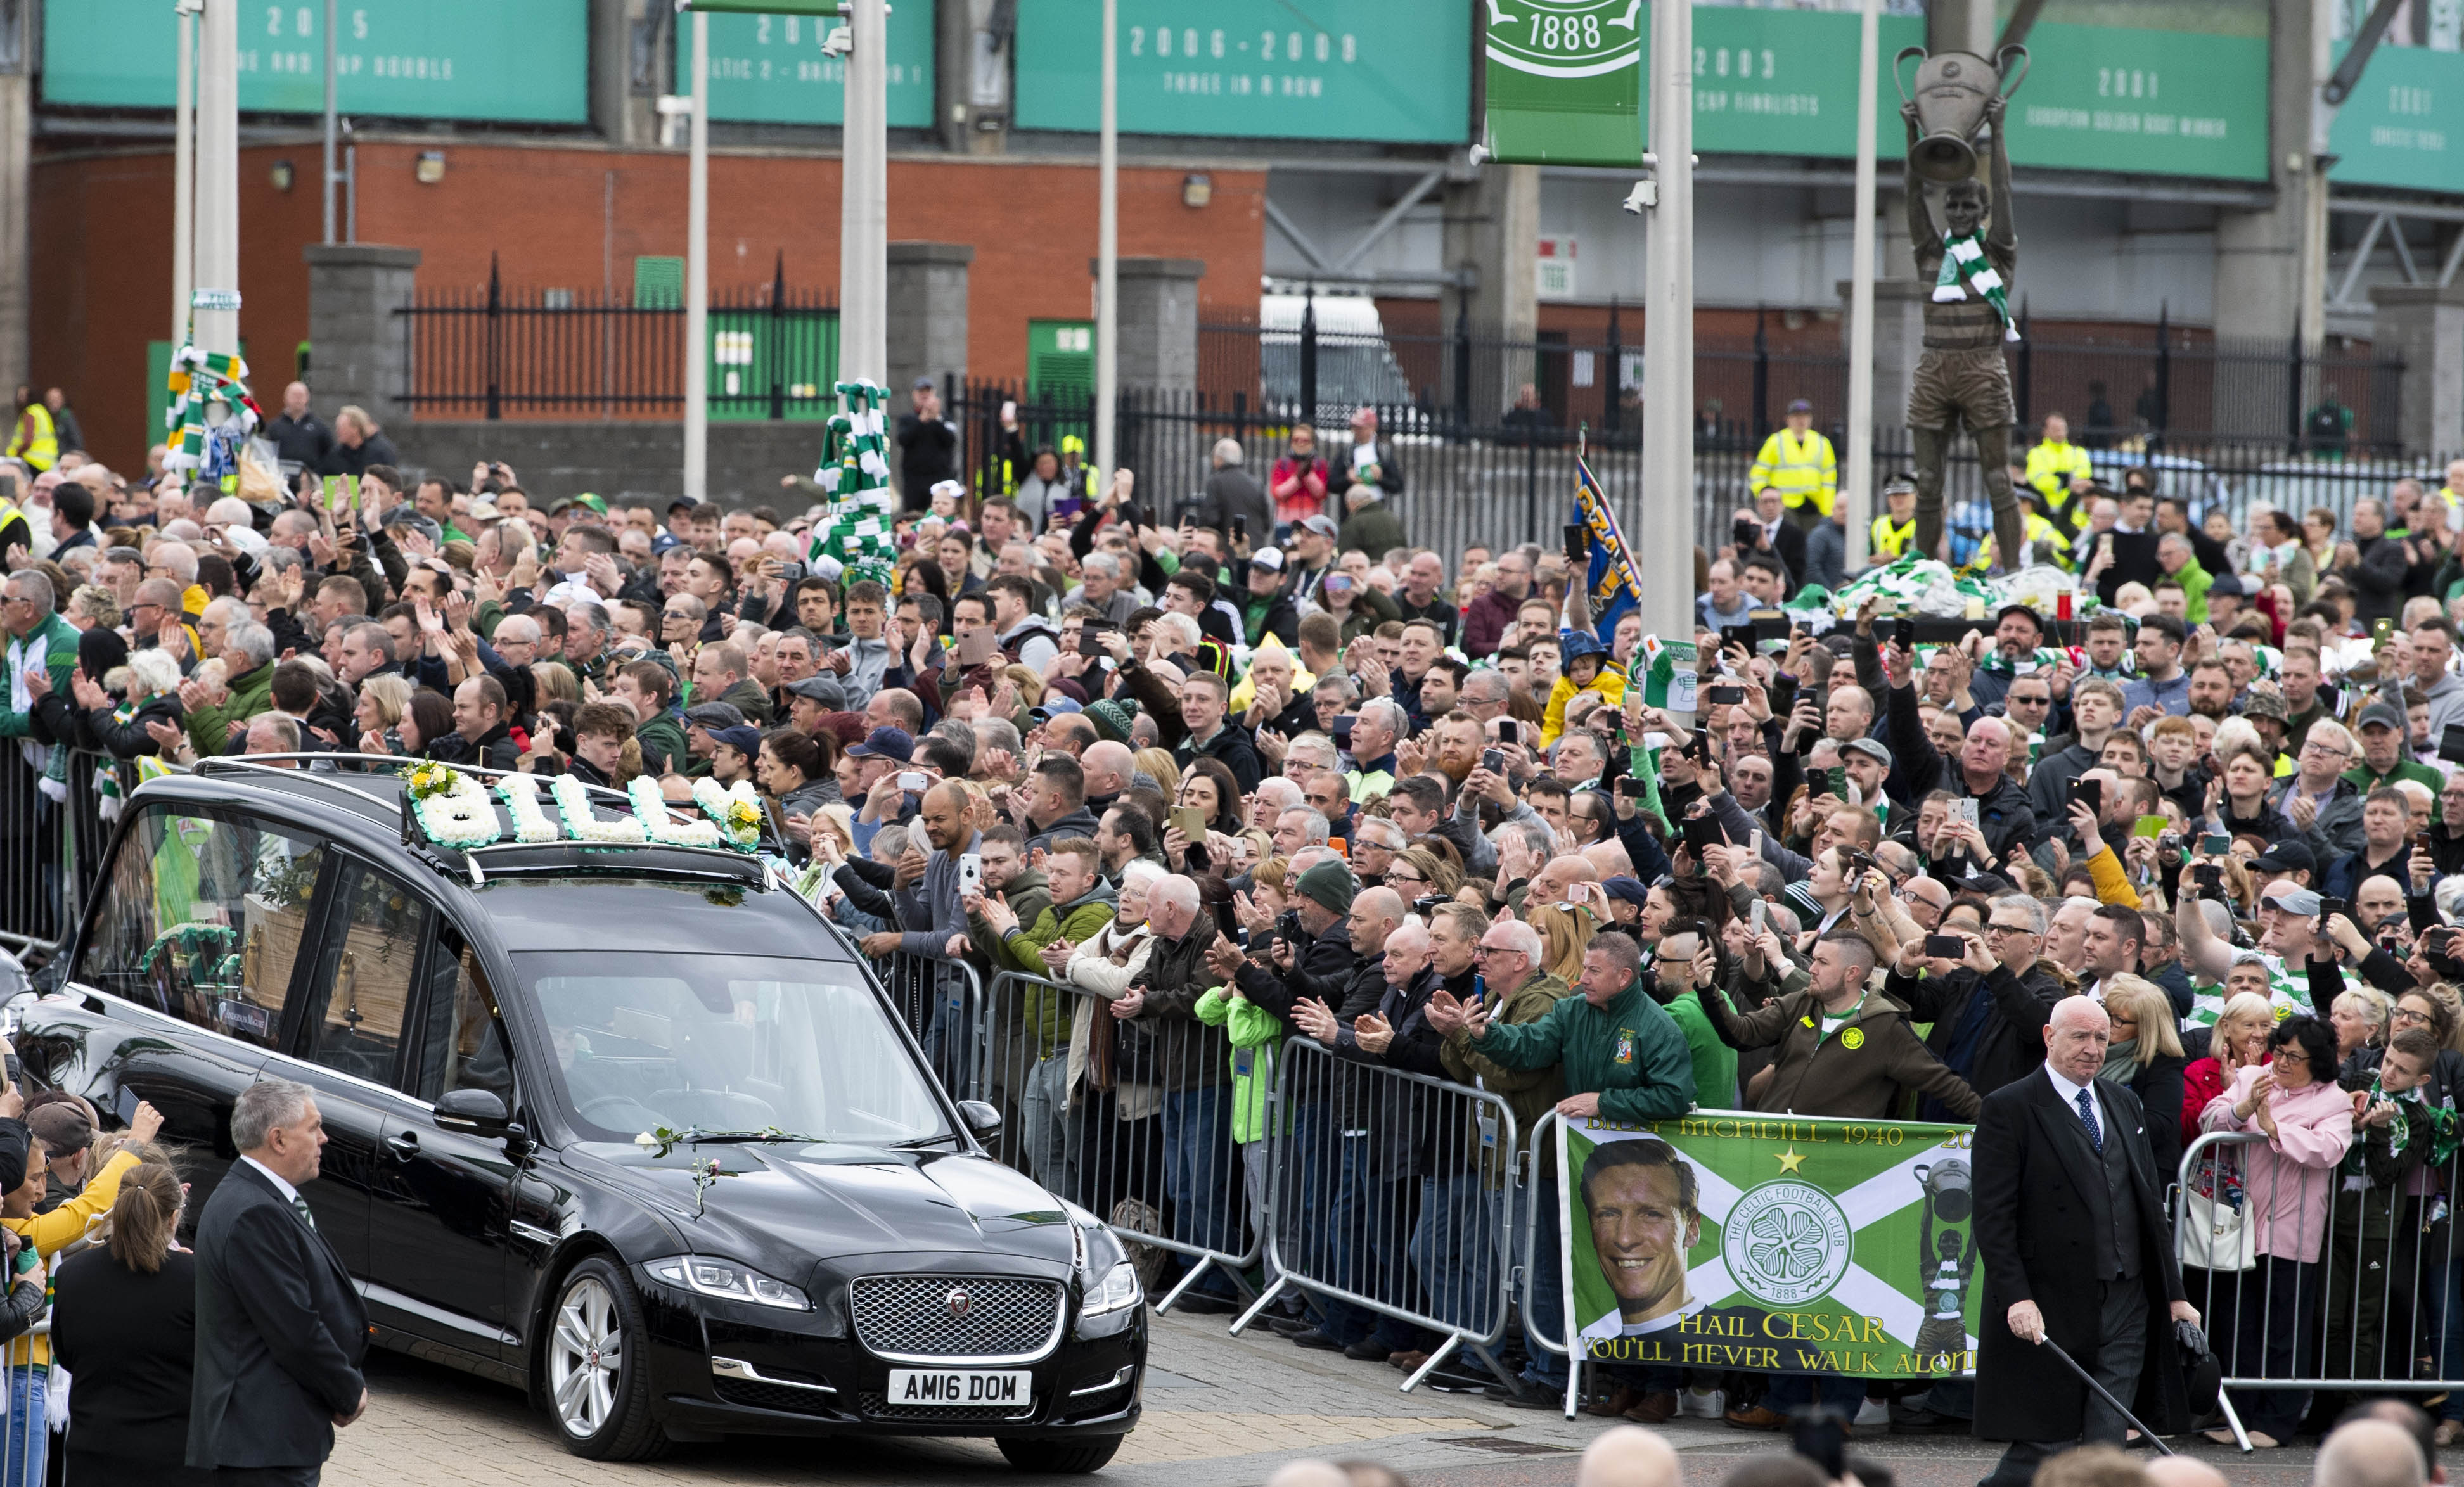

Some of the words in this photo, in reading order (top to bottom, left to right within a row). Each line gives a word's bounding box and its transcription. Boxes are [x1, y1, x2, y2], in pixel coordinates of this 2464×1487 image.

[267, 6, 368, 39] 205
[757, 13, 847, 45] 201
[1530, 13, 1601, 51] 1888
[1131, 26, 1225, 58] 2006
[337, 53, 363, 75] UP
[373, 54, 452, 80] DOUBLE
[1694, 46, 1774, 79] 2003
[1164, 70, 1221, 94] THREE
[1230, 73, 1252, 96] IN
[1261, 74, 1273, 96] A
[1281, 75, 1323, 97] ROW
[2098, 67, 2157, 99] 2001
[1697, 90, 1728, 113] CUP
[1734, 91, 1819, 117] FINALISTS
[415, 773, 760, 853] BILLY
[225, 1009, 247, 1023] ANDERSON
[1680, 1119, 1828, 1143] MCNEILL
[1842, 1125, 1904, 1146] 1940
[1729, 1218, 1745, 1242] THE
[1738, 1190, 1773, 1220] CELTIC
[1776, 1187, 1832, 1218] FOOTBALL
[1828, 1216, 1845, 1248] CLUB
[1771, 1287, 1798, 1299] 1888
[1678, 1312, 1754, 1338] HAIL
[1762, 1311, 1889, 1344] CESAR
[1581, 1336, 1671, 1362] YOU'LL
[1683, 1343, 1782, 1369] NEVER
[1795, 1349, 1883, 1374] WALK
[904, 1374, 961, 1401] AM16
[968, 1375, 1017, 1401] DOM
